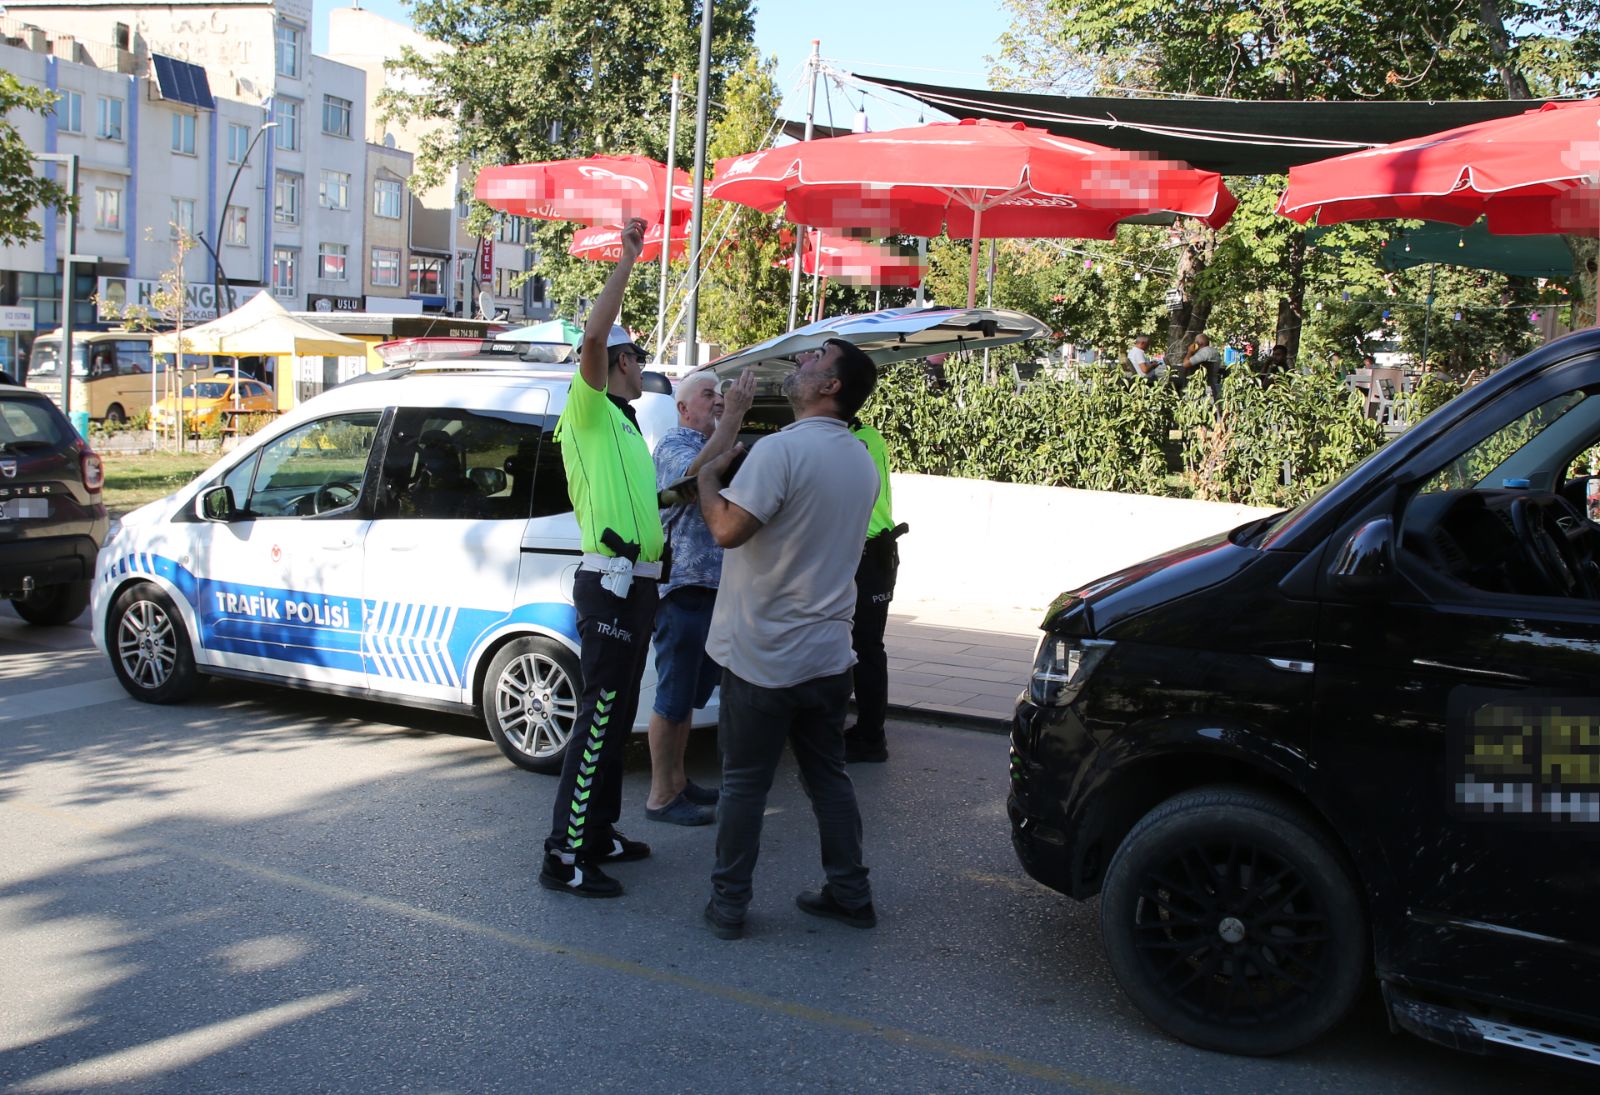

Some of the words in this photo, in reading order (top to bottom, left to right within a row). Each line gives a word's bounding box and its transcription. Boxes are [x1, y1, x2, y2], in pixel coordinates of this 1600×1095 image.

[337, 299, 357, 310] USLU
[215, 590, 281, 620] TRAFİK
[285, 598, 350, 629] POLİSİ
